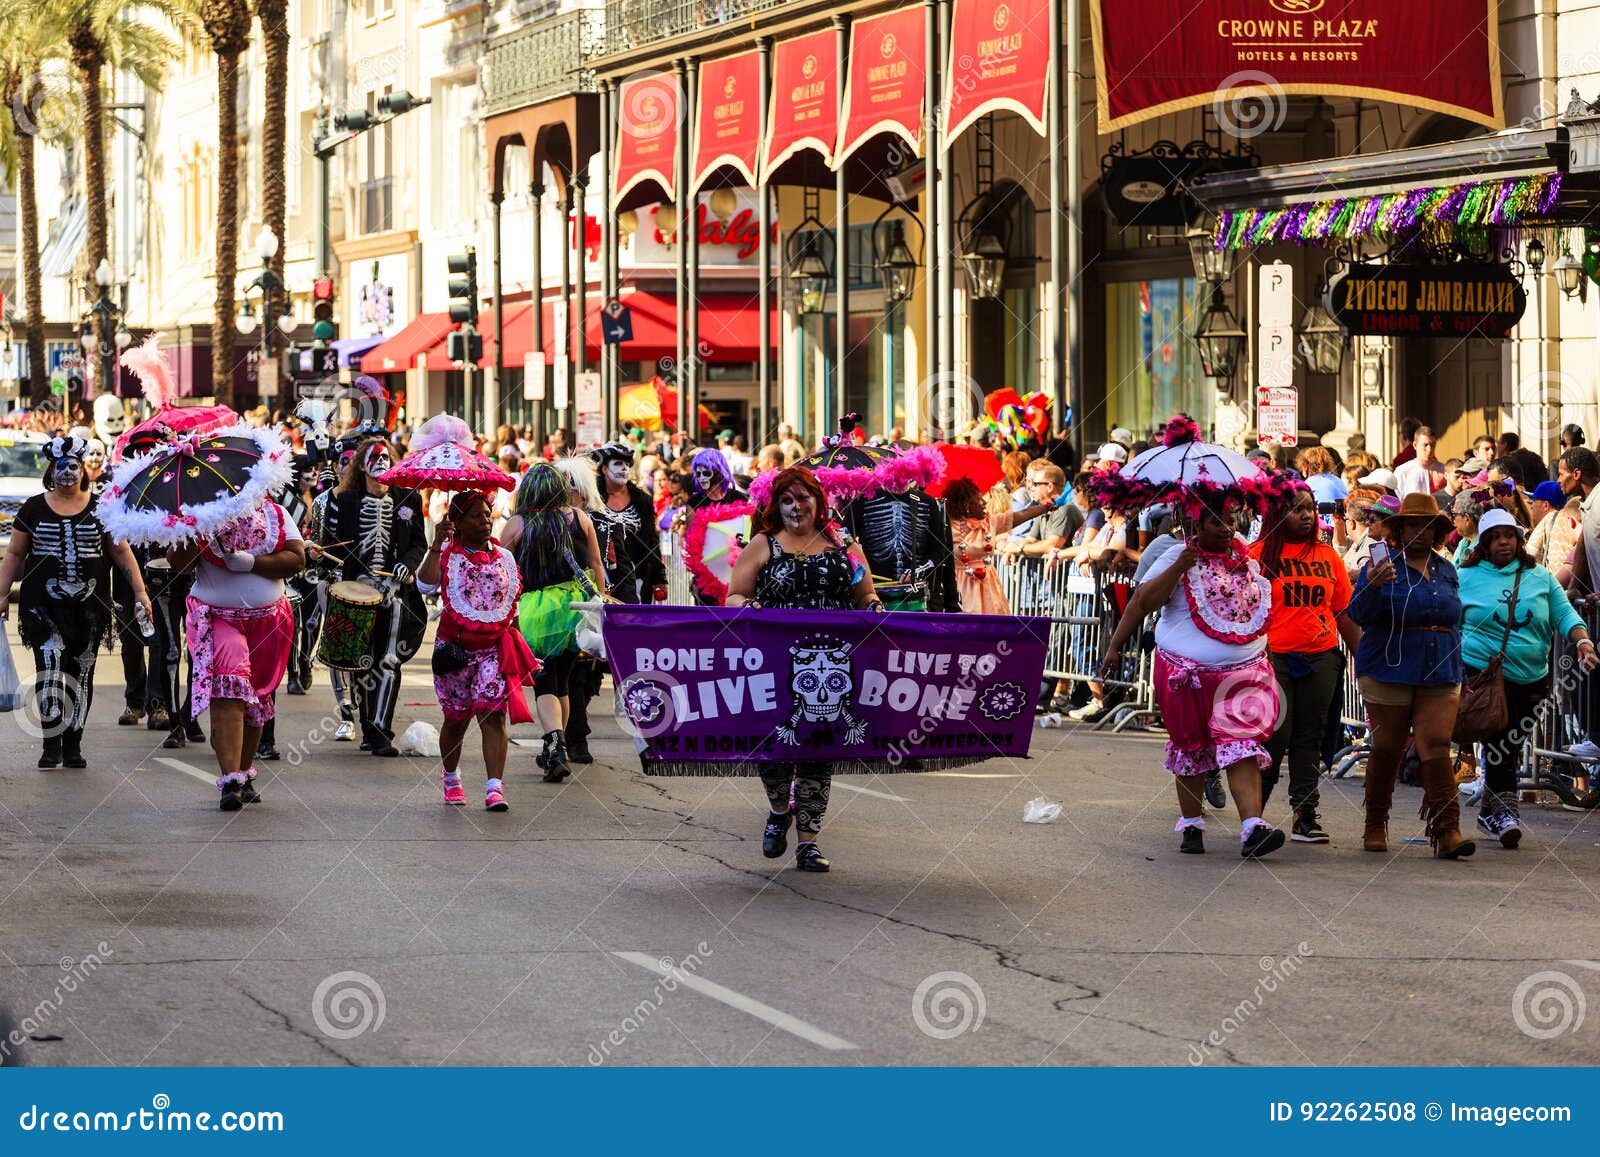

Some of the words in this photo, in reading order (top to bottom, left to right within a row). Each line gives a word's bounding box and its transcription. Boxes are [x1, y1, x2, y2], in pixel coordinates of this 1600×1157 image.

[1218, 20, 1304, 38] CROWNE
[1237, 51, 1285, 61] HOTELS
[1289, 52, 1297, 61] &
[1303, 51, 1359, 61] RESORTS
[1345, 280, 1407, 311] ZYDECO
[1416, 280, 1515, 313] JAMBALAYA
[1430, 315, 1443, 331] &
[1282, 580, 1326, 608] the
[635, 647, 715, 672] BONE
[724, 647, 764, 671] TO
[888, 649, 952, 675] LIVE
[958, 653, 996, 676] TO
[671, 672, 777, 723] LIVE
[858, 668, 976, 720] BONE
